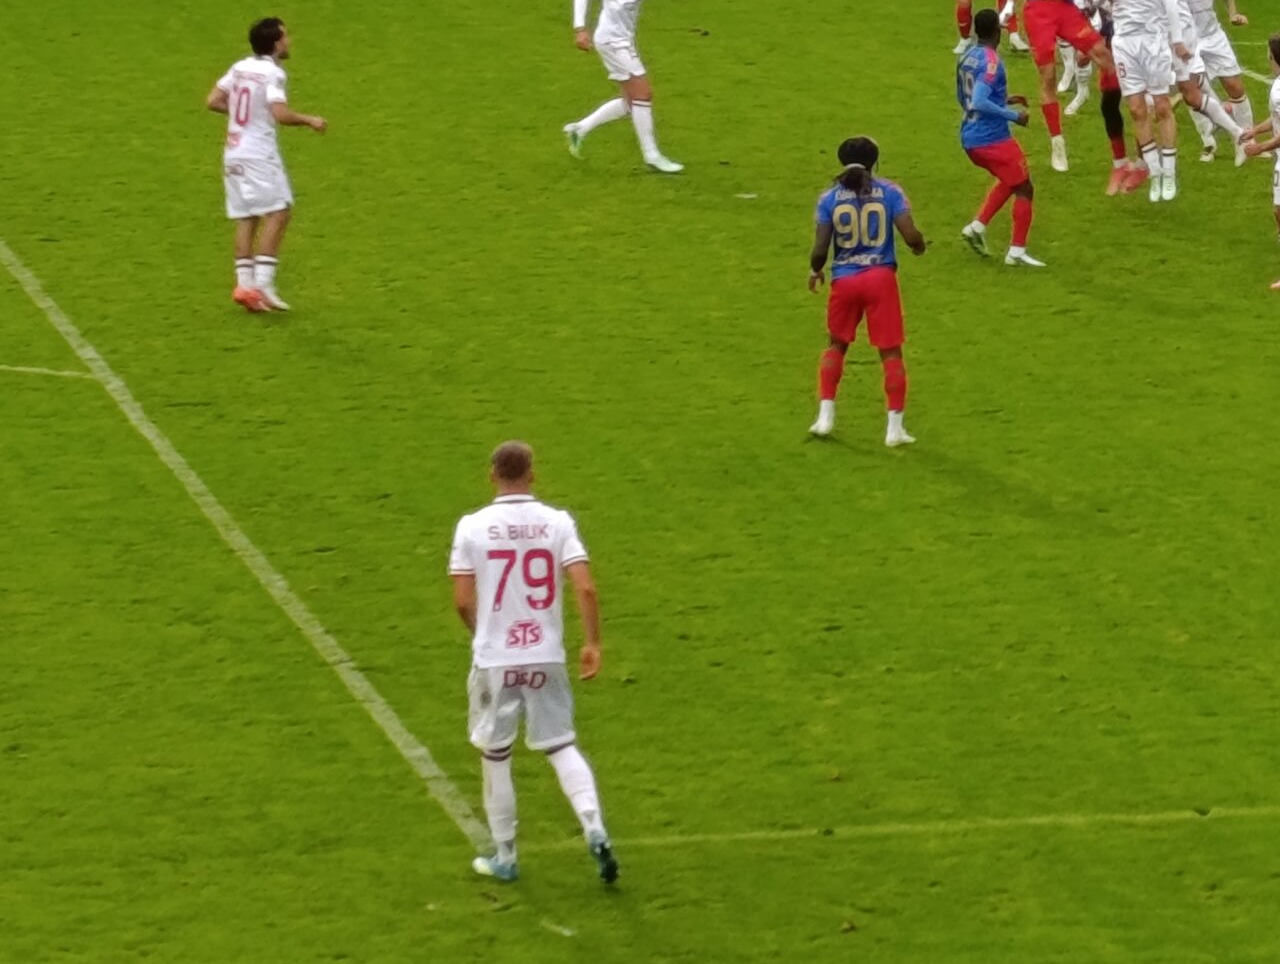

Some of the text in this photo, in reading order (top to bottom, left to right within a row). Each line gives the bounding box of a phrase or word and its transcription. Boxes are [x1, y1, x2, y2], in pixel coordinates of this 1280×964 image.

[833, 202, 887, 249] 90
[487, 548, 556, 612] 79
[507, 621, 543, 647] STS
[503, 670, 546, 689] D&D
